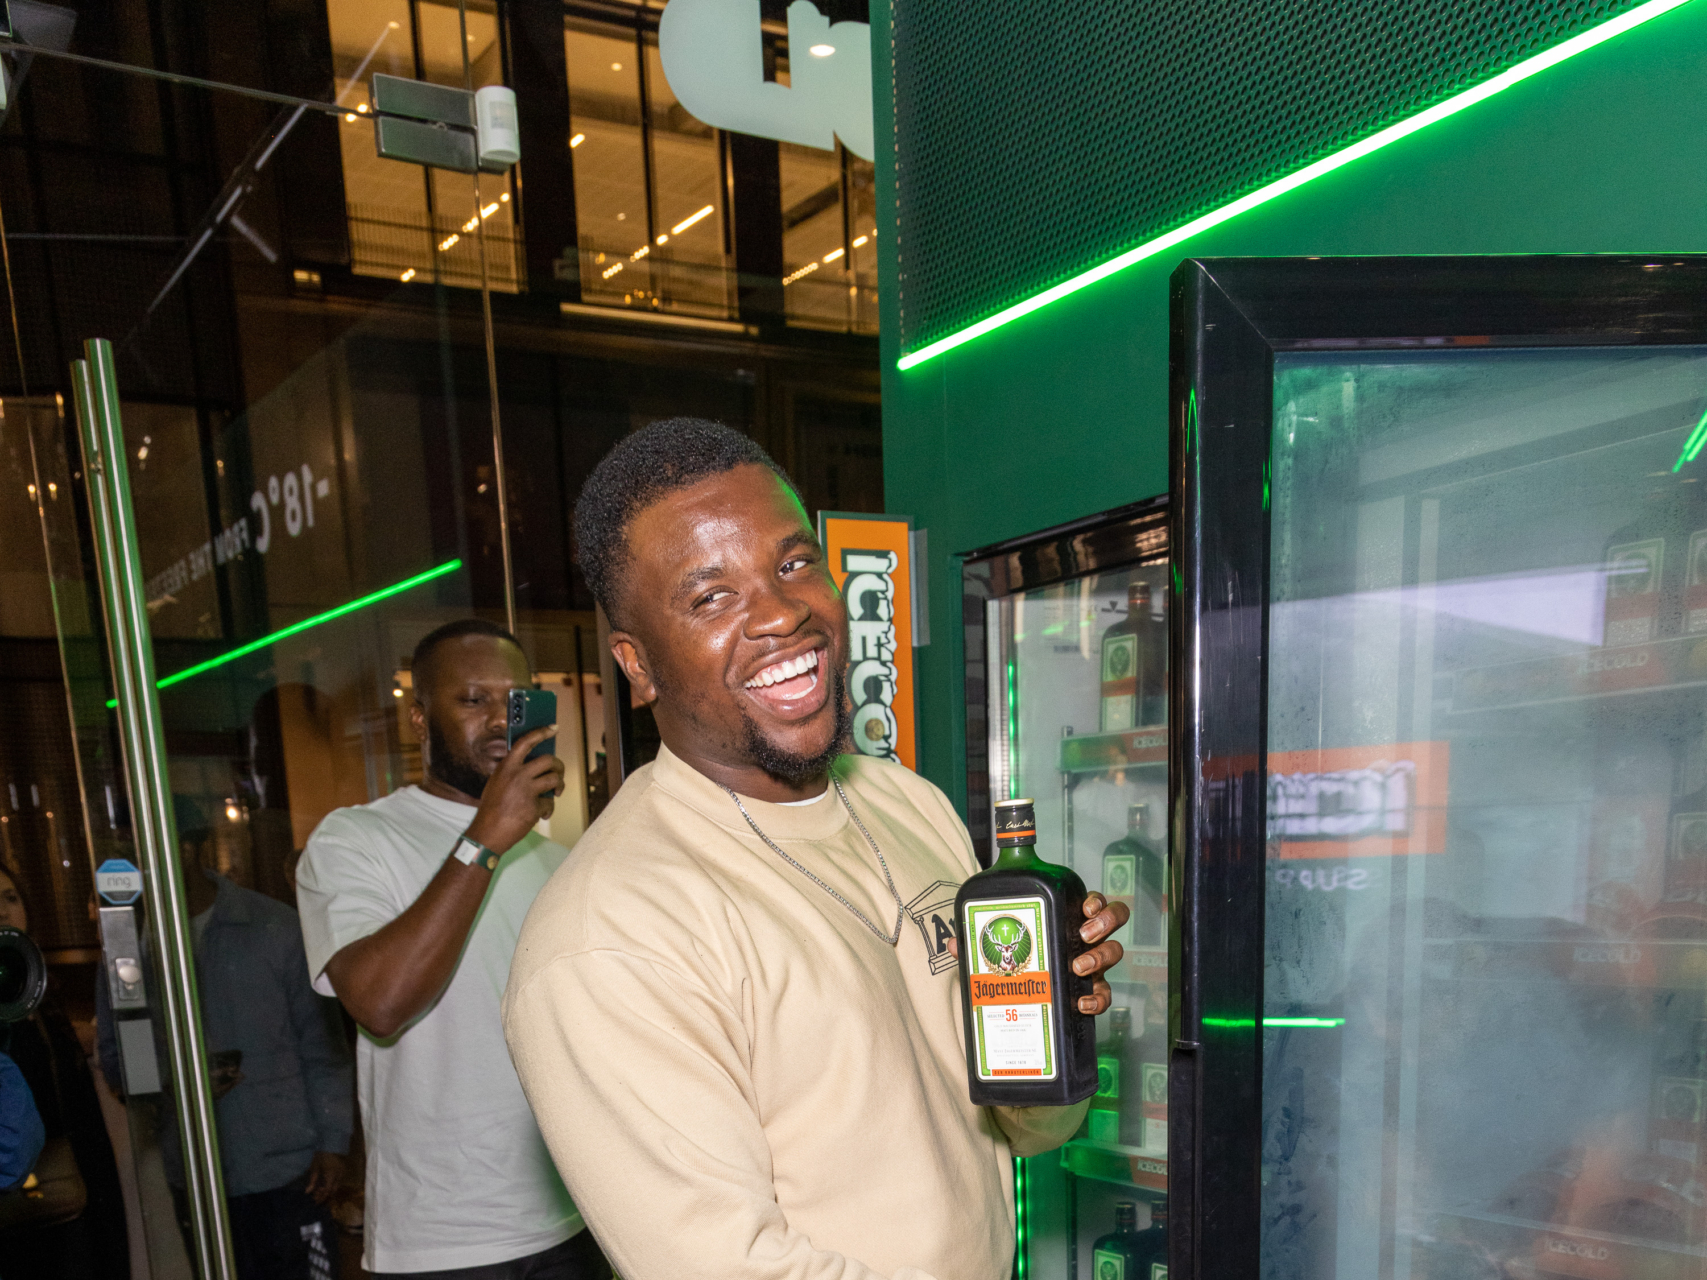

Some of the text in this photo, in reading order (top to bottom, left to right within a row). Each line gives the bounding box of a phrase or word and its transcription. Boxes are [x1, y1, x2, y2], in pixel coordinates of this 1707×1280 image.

[846, 550, 899, 764] ICECO
[1133, 733, 1168, 750] ICECOL
[106, 874, 132, 890] ring
[1132, 952, 1168, 967] ICECOL
[974, 979, 1047, 999] Jägermeister
[1005, 1009, 1018, 1021] 56
[1137, 1156, 1168, 1176] ICECOL
